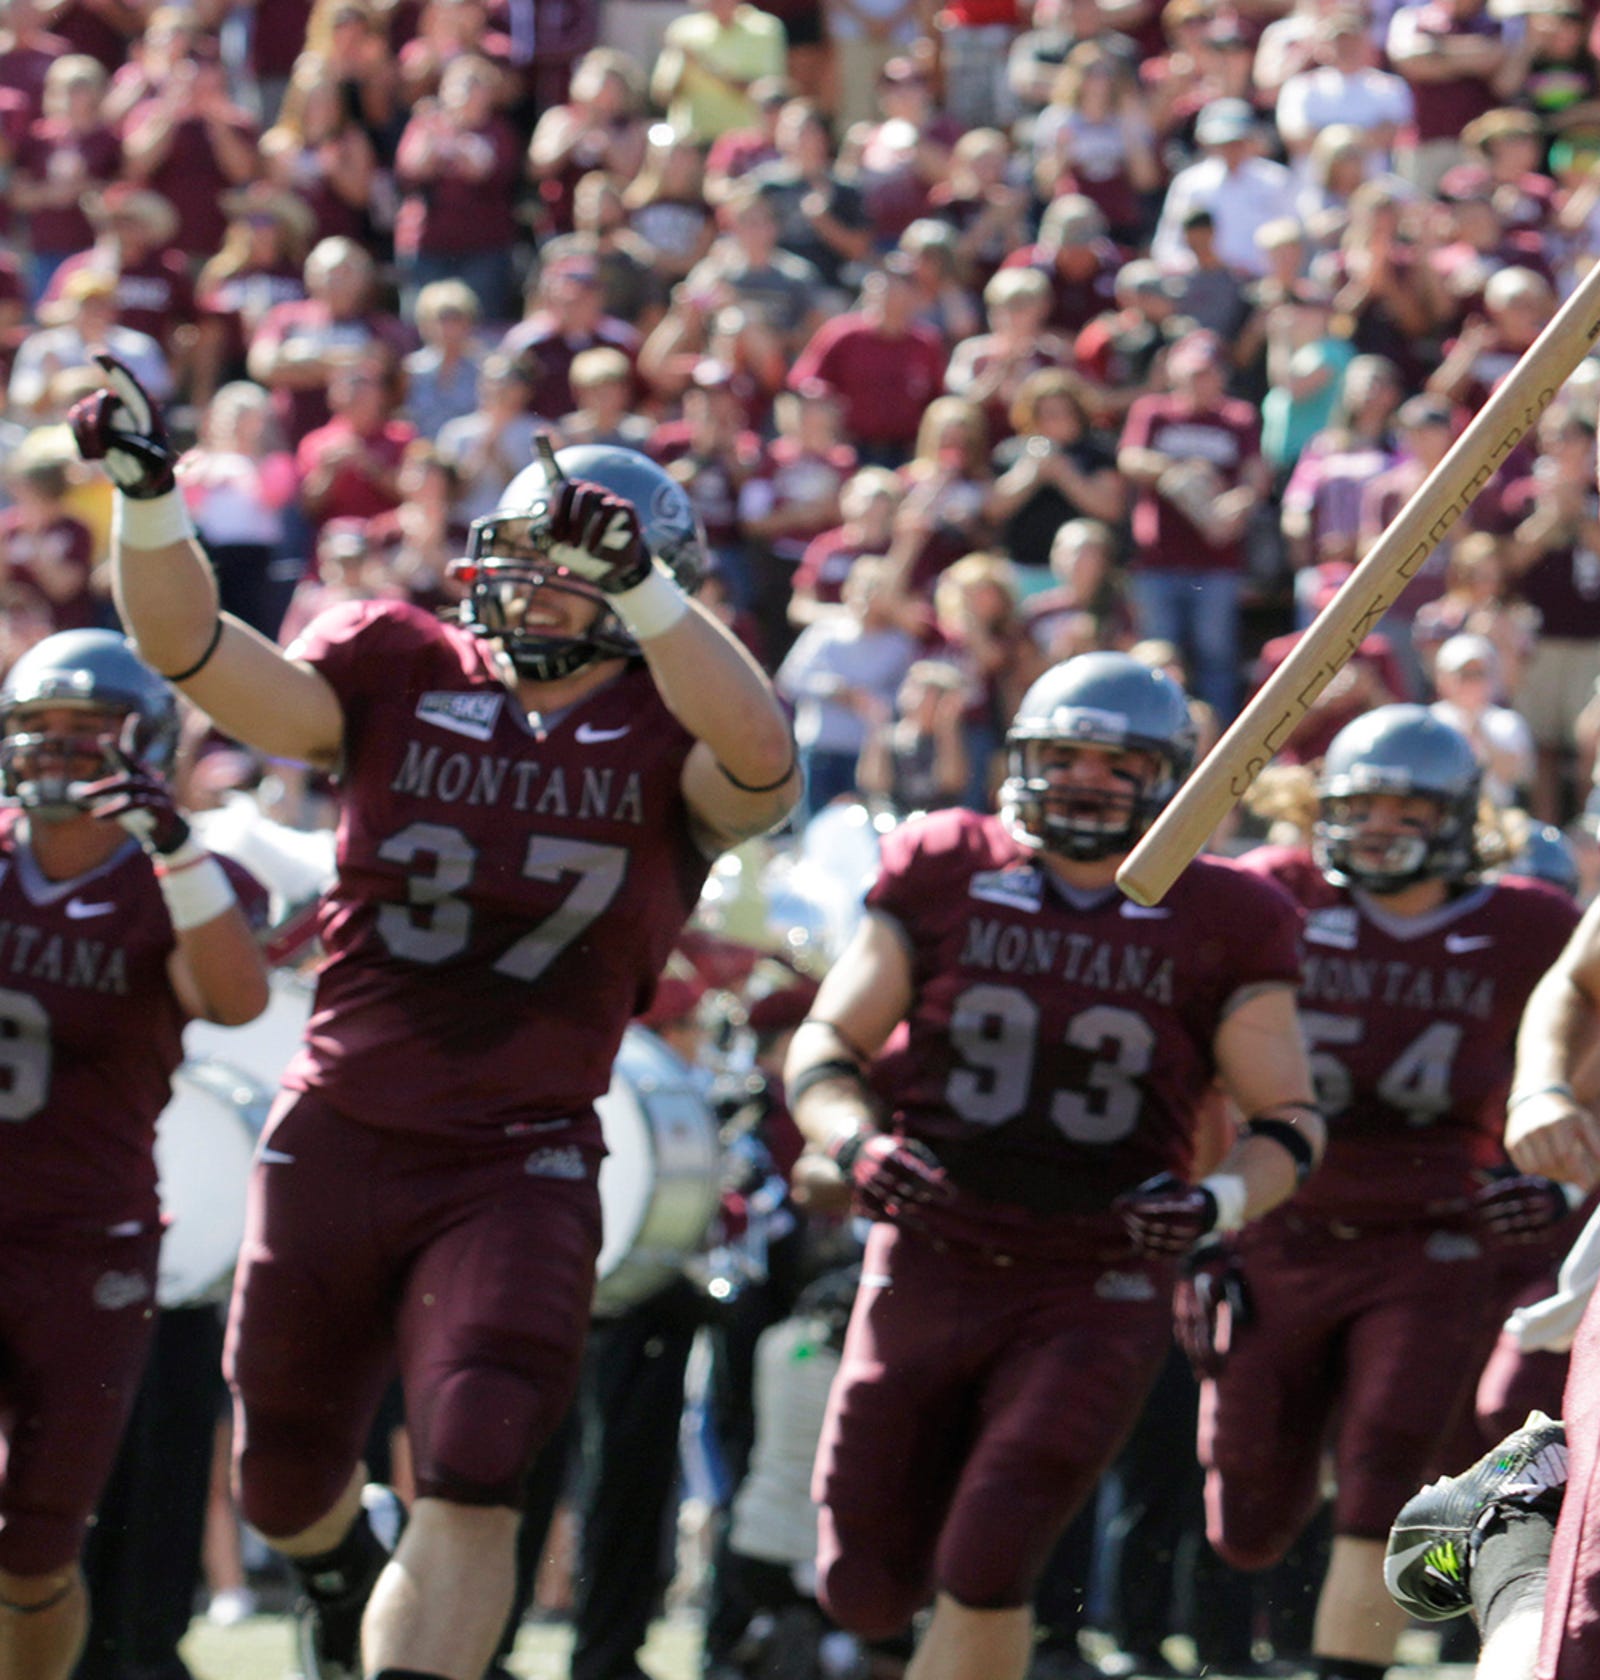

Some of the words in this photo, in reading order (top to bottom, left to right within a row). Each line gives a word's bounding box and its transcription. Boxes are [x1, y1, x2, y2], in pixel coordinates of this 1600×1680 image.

[1221, 593, 1394, 799] KILLS
[390, 740, 644, 825] MONTANA
[0, 919, 131, 995] TANA
[375, 821, 630, 984] 37
[960, 917, 1176, 1006] MONTANA
[945, 982, 1156, 1144] 93
[1297, 1008, 1464, 1127] 54
